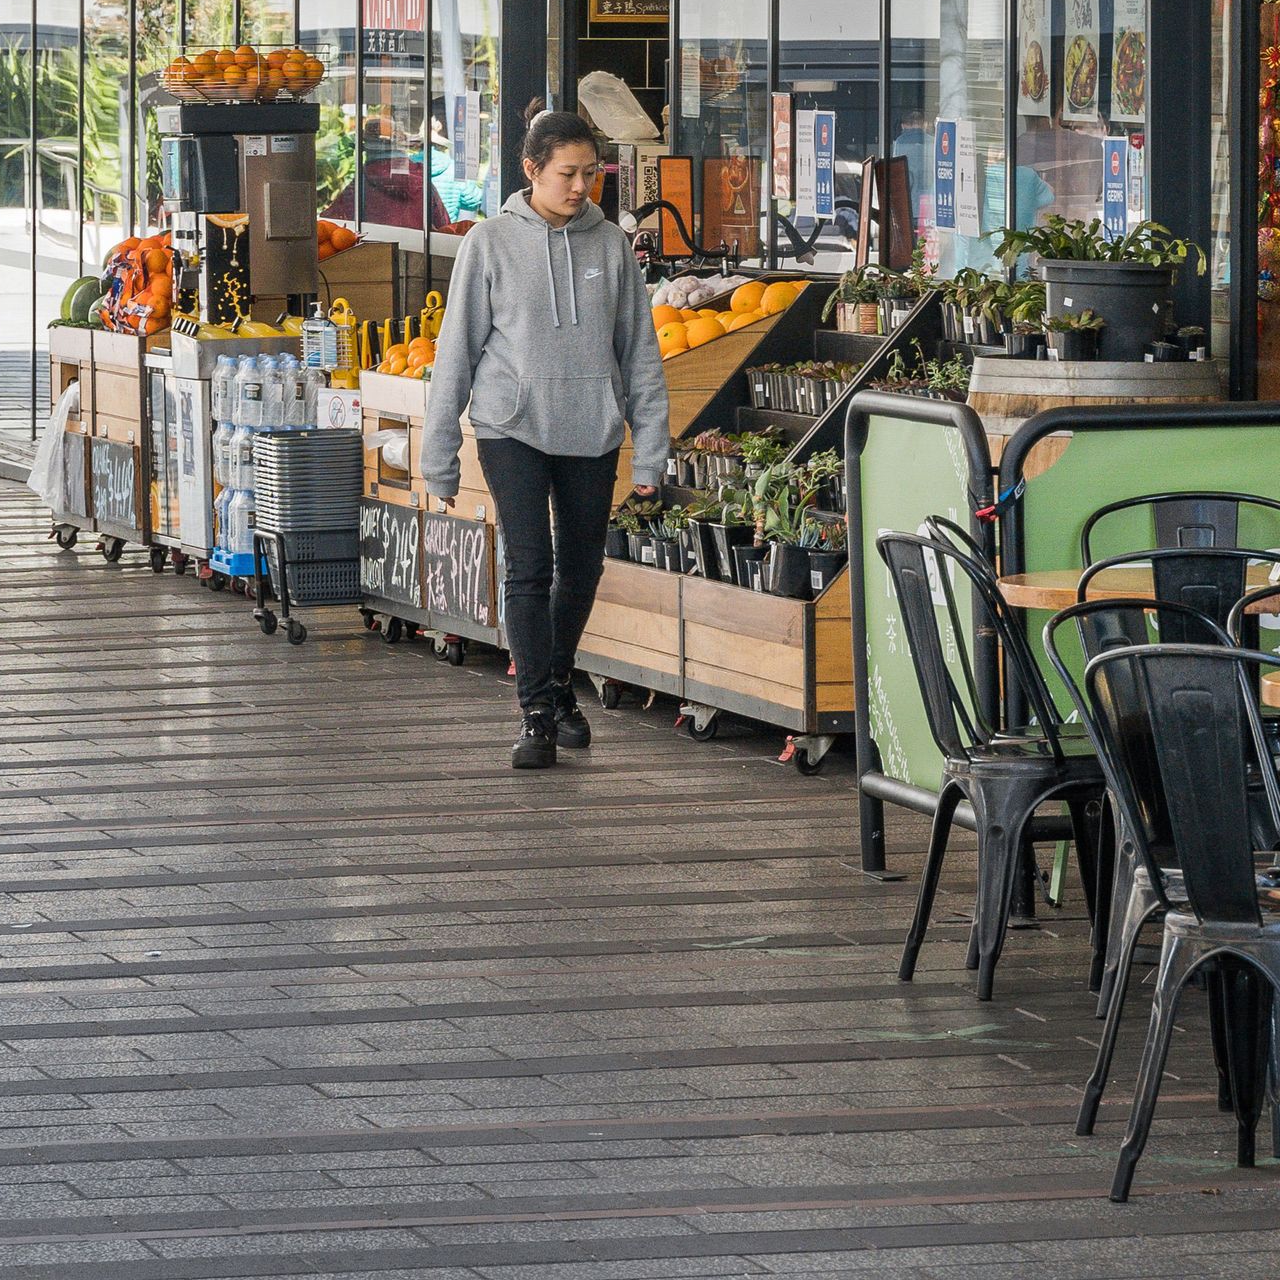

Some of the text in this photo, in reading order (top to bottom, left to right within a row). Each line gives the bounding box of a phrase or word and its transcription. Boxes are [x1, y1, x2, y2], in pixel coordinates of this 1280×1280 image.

[937, 168, 953, 180] GERMS
[1107, 190, 1124, 202] GERMS
[360, 505, 381, 541] HONEY
[382, 504, 419, 599] $2.49
[424, 519, 484, 620] GARLIC $1.99
